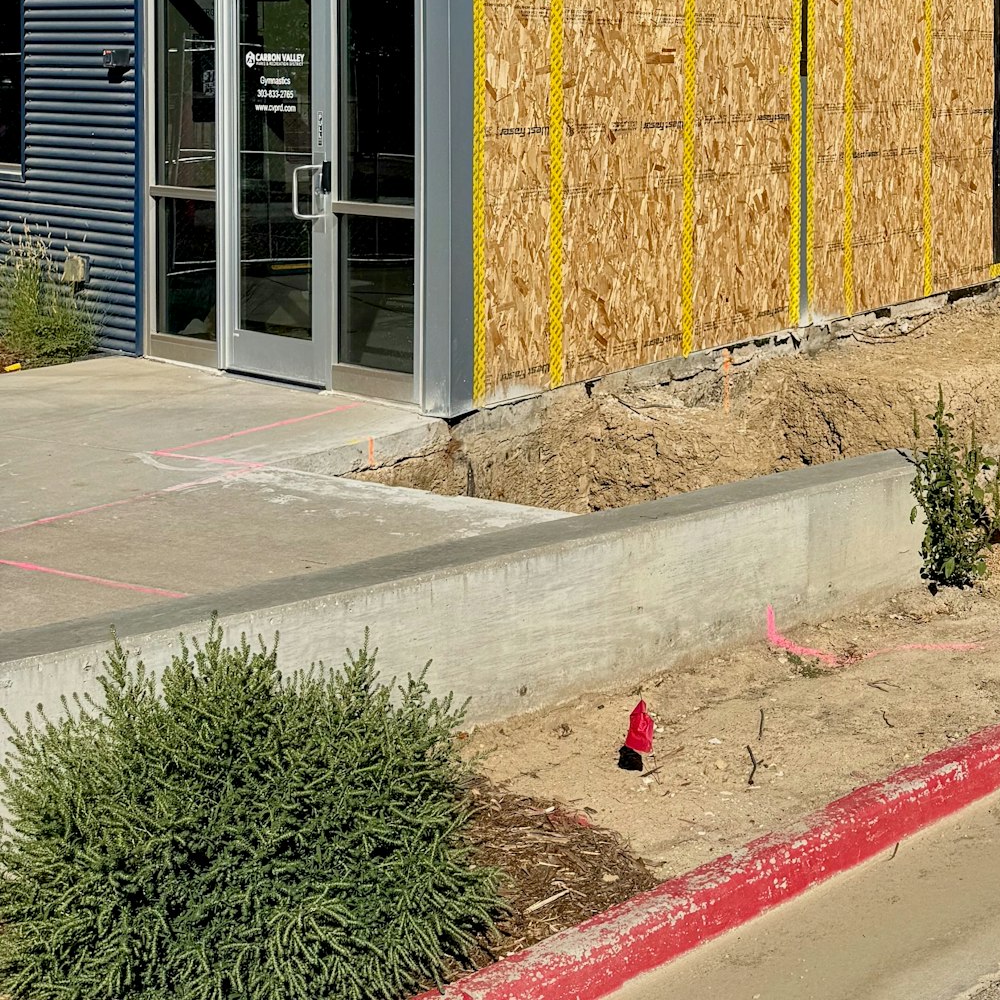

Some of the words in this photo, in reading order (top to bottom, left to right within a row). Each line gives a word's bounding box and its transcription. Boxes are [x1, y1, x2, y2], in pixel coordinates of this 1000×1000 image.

[255, 53, 281, 62] CARBON
[281, 53, 305, 62] VALLEY
[260, 75, 291, 86] Gymnastics
